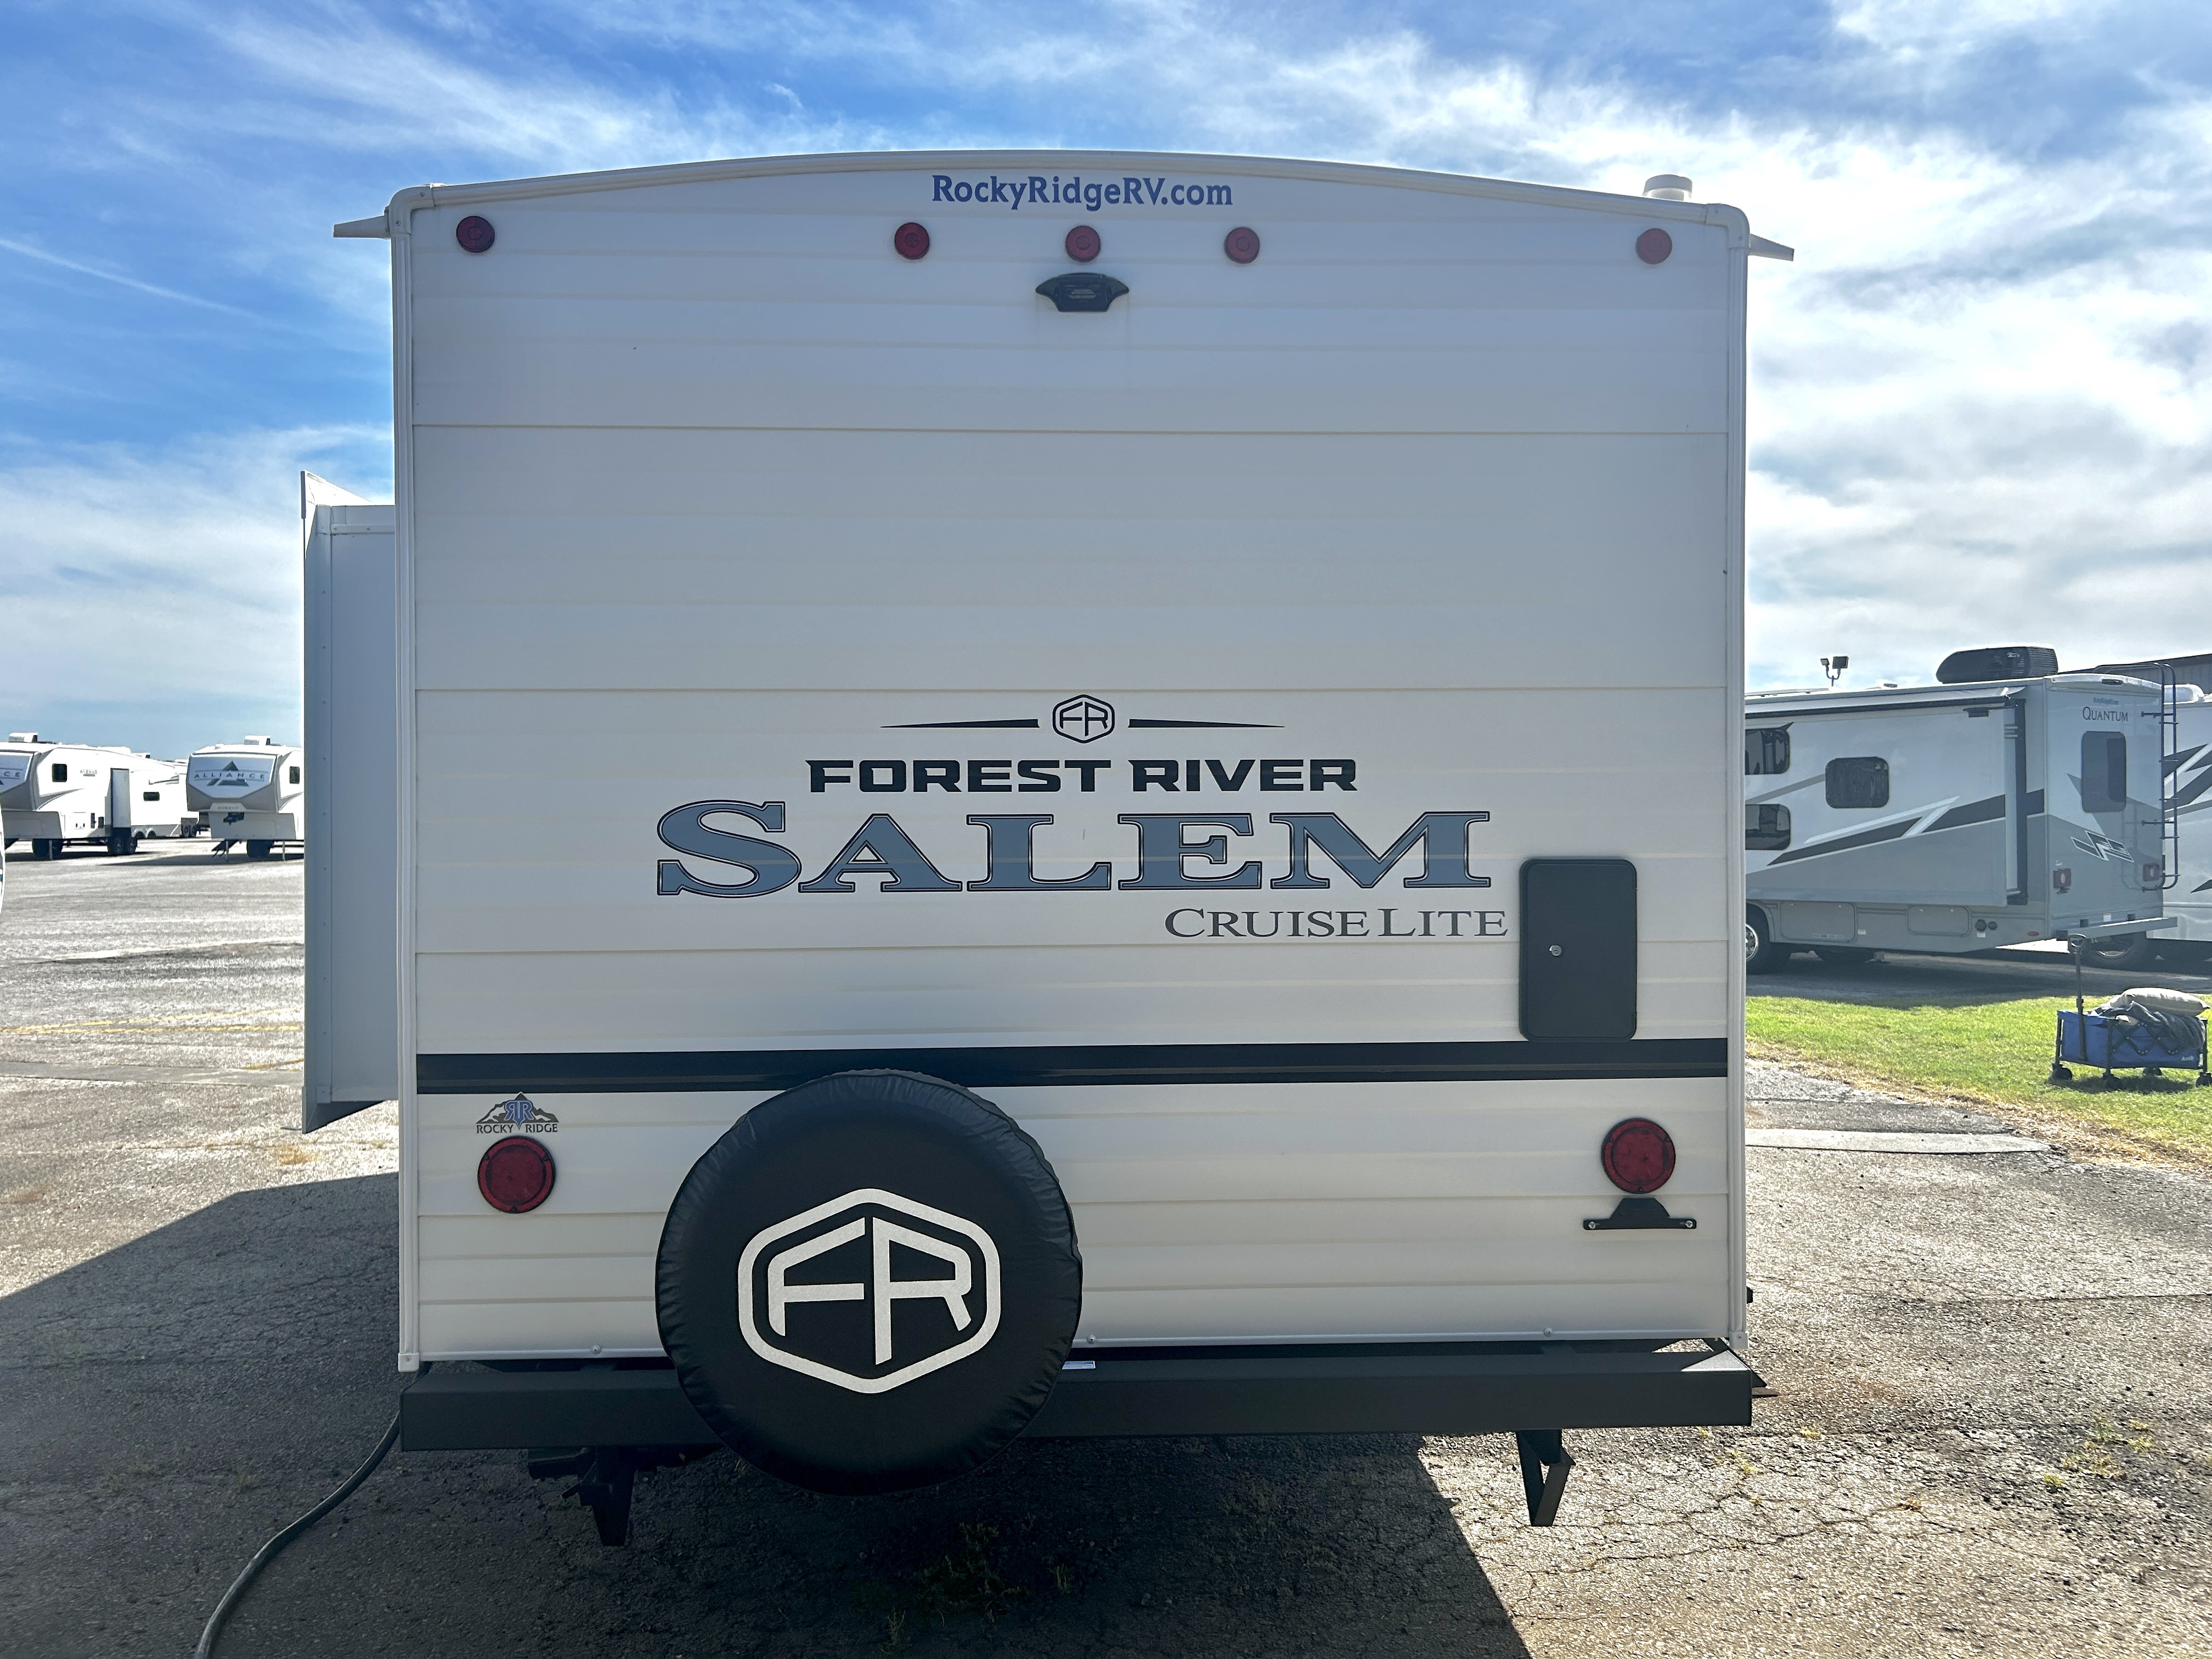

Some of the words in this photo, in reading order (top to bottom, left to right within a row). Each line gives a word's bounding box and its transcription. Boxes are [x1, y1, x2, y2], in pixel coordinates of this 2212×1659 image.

[932, 175, 1232, 211] RockyRidgeRV.com
[2083, 706, 2128, 721] QUANTUM
[805, 760, 1111, 792] FOREST
[1128, 759, 1357, 792] RIVER
[657, 800, 1491, 898] SALEM
[476, 1124, 513, 1134] ROCKY
[525, 1123, 558, 1133] RIDGE
[768, 1216, 973, 1365] FR
